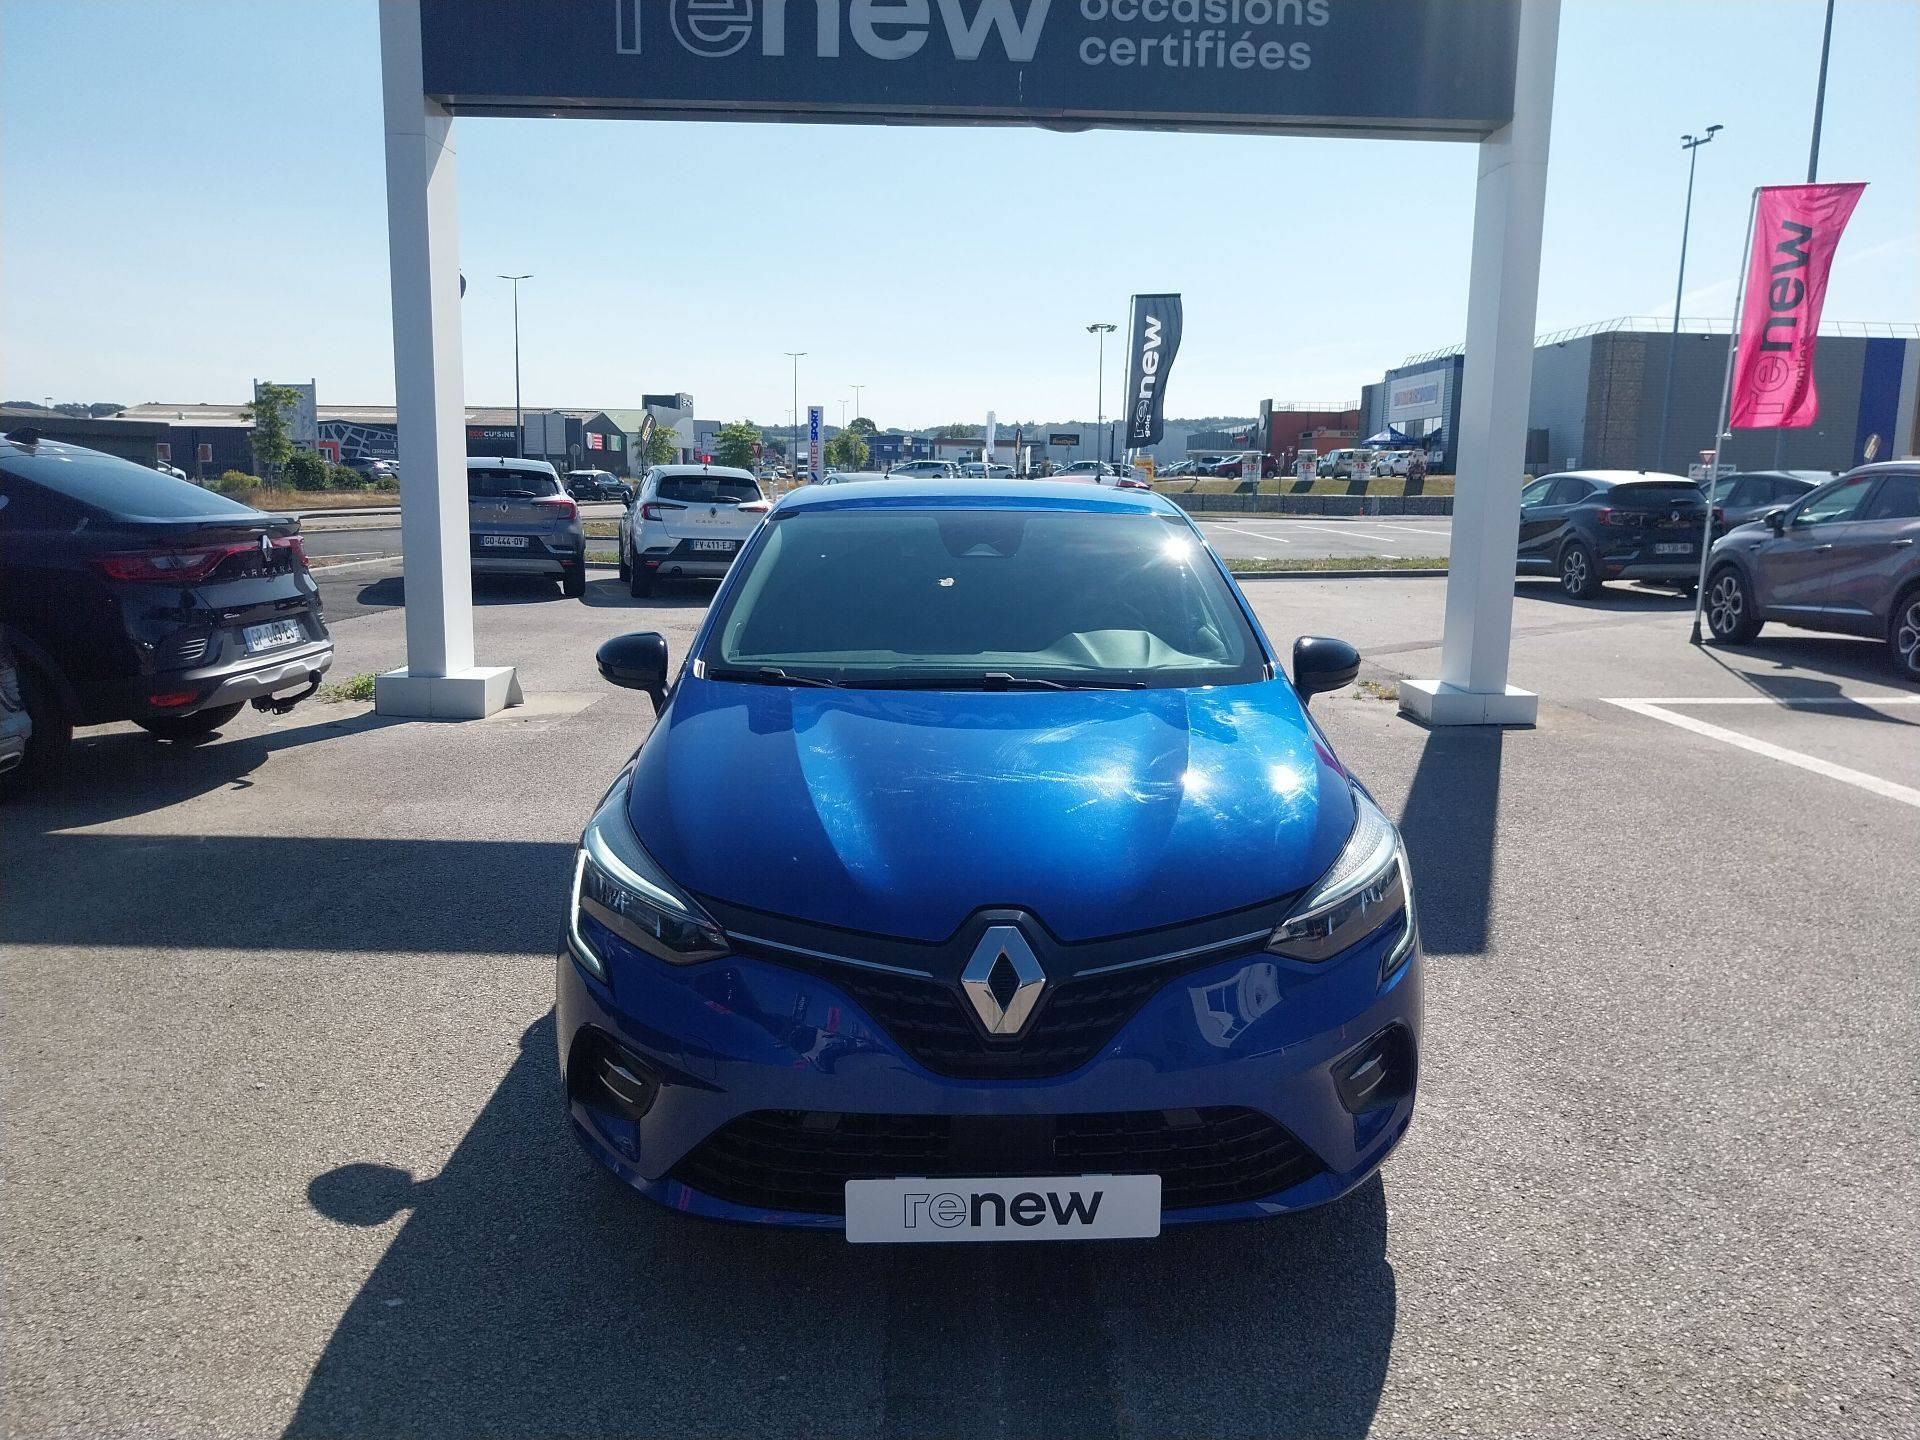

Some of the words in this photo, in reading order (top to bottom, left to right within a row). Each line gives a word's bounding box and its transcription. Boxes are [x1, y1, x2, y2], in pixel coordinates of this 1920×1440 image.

[615, 0, 1053, 62] renew
[1079, 0, 1331, 27] occasions
[1078, 29, 1313, 71] certifiées
[1747, 219, 1813, 415] renew
[1133, 315, 1162, 438] renew
[810, 408, 819, 472] INTERSPORT
[1144, 414, 1152, 438] gold
[904, 1191, 1104, 1229] renew
